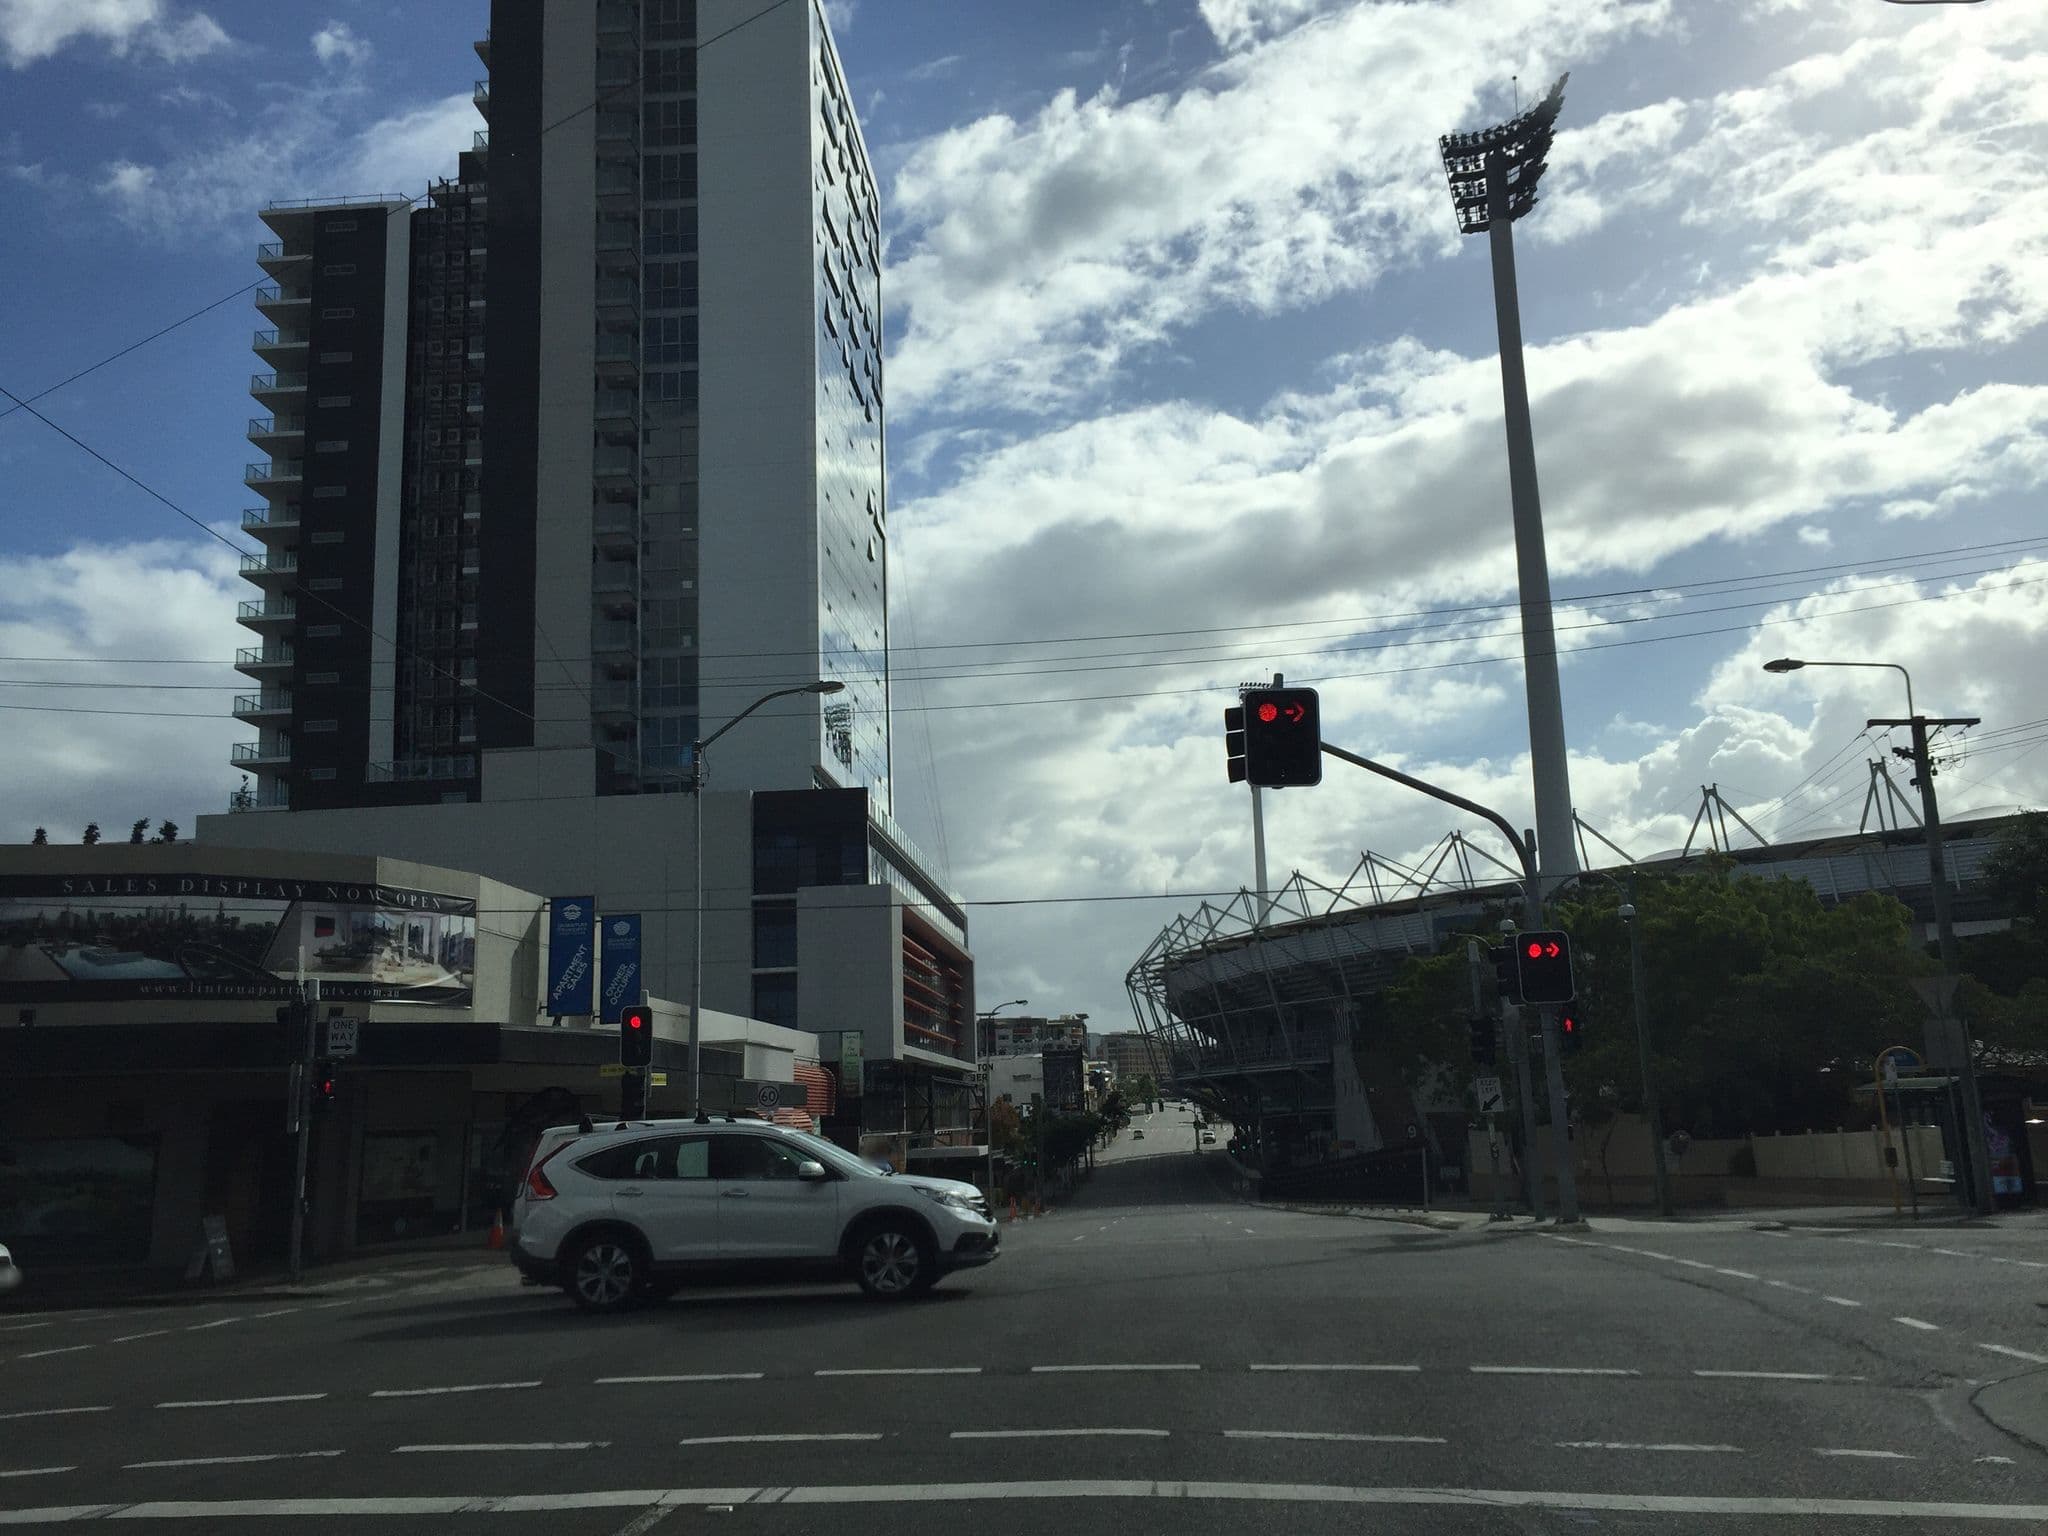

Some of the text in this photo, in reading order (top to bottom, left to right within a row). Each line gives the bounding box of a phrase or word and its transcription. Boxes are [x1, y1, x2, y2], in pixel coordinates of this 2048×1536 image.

[63, 878, 442, 910] SALES DISPLAY NOW OPEN
[552, 944, 589, 1001] APARTMENT
[566, 962, 589, 991] SALES
[605, 963, 628, 998] OWNER
[610, 962, 638, 1006] OCCUPIER
[331, 1031, 355, 1041] WAY
[333, 1021, 354, 1030] ONE
[760, 1089, 776, 1102] 60
